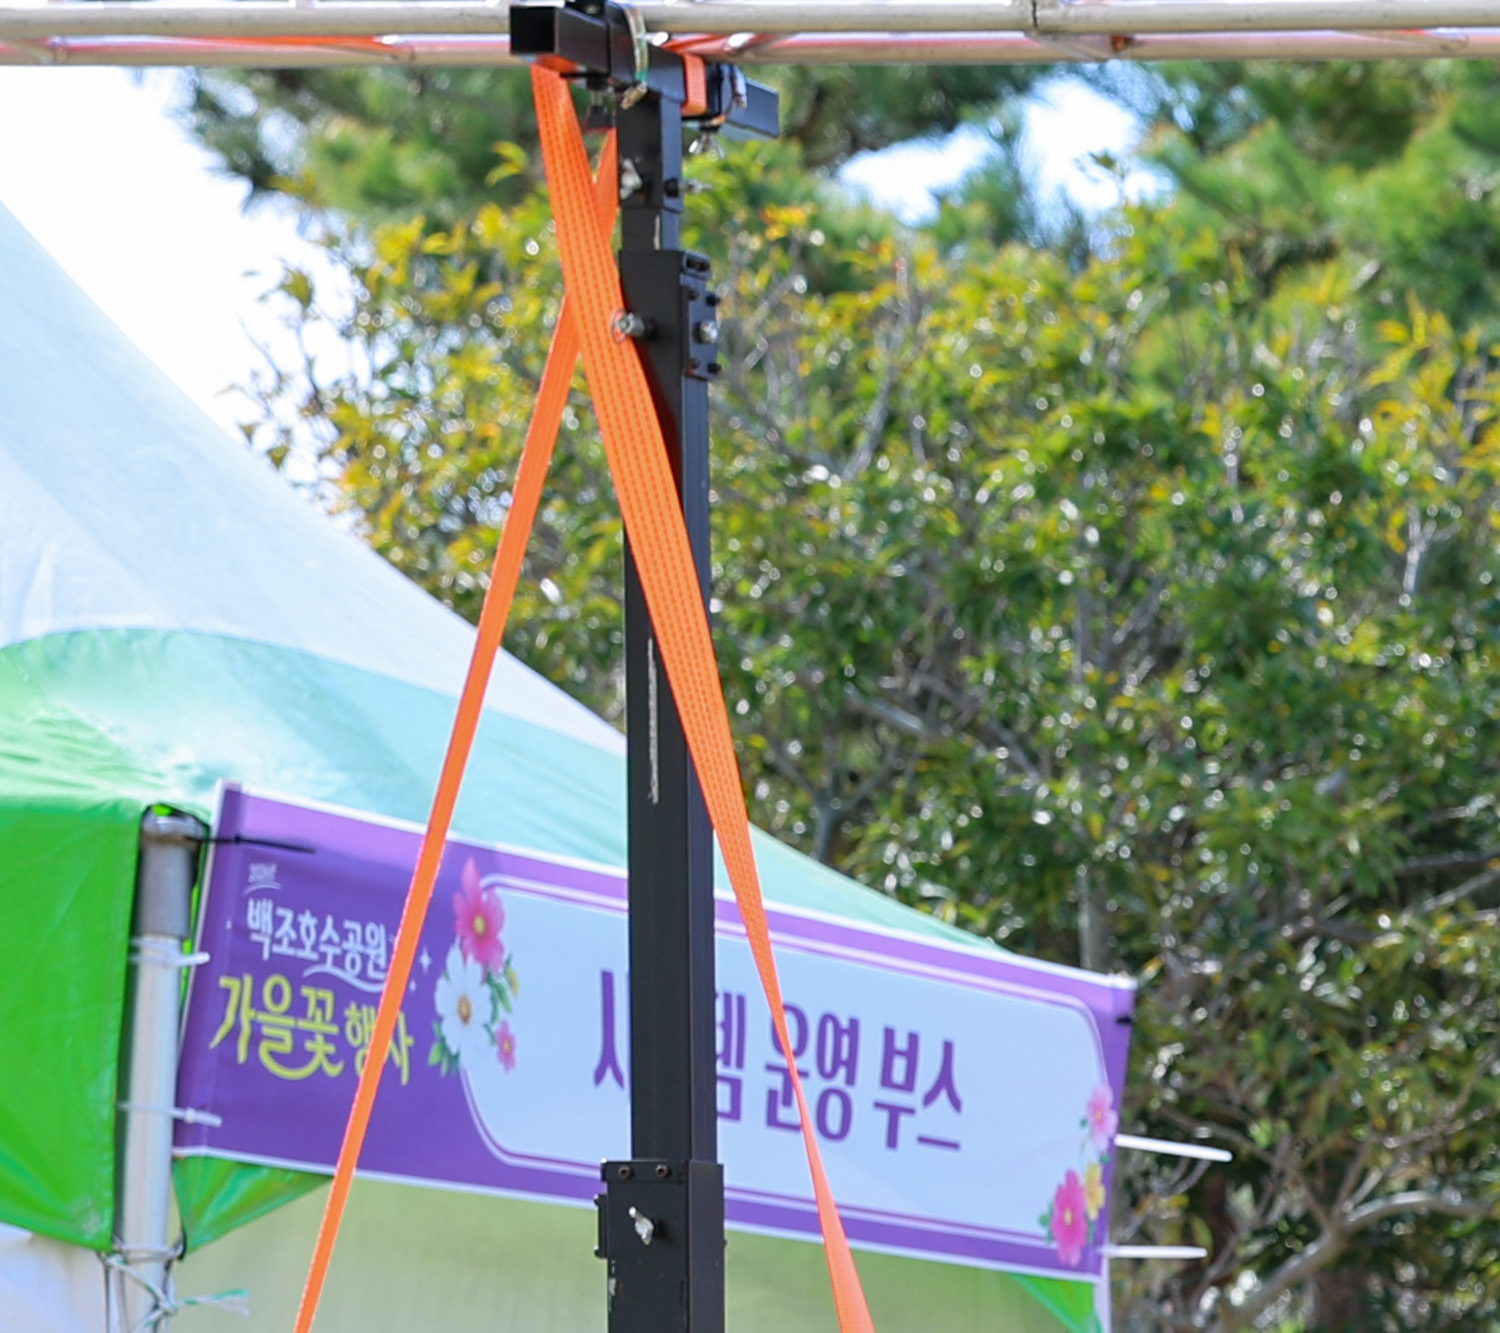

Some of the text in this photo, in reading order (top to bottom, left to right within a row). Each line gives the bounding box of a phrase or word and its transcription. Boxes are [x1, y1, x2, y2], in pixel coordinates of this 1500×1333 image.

[246, 898, 387, 981] 백조호수공원
[208, 973, 345, 1081] 가을꽃
[593, 969, 963, 1150] 시템 운영 부스
